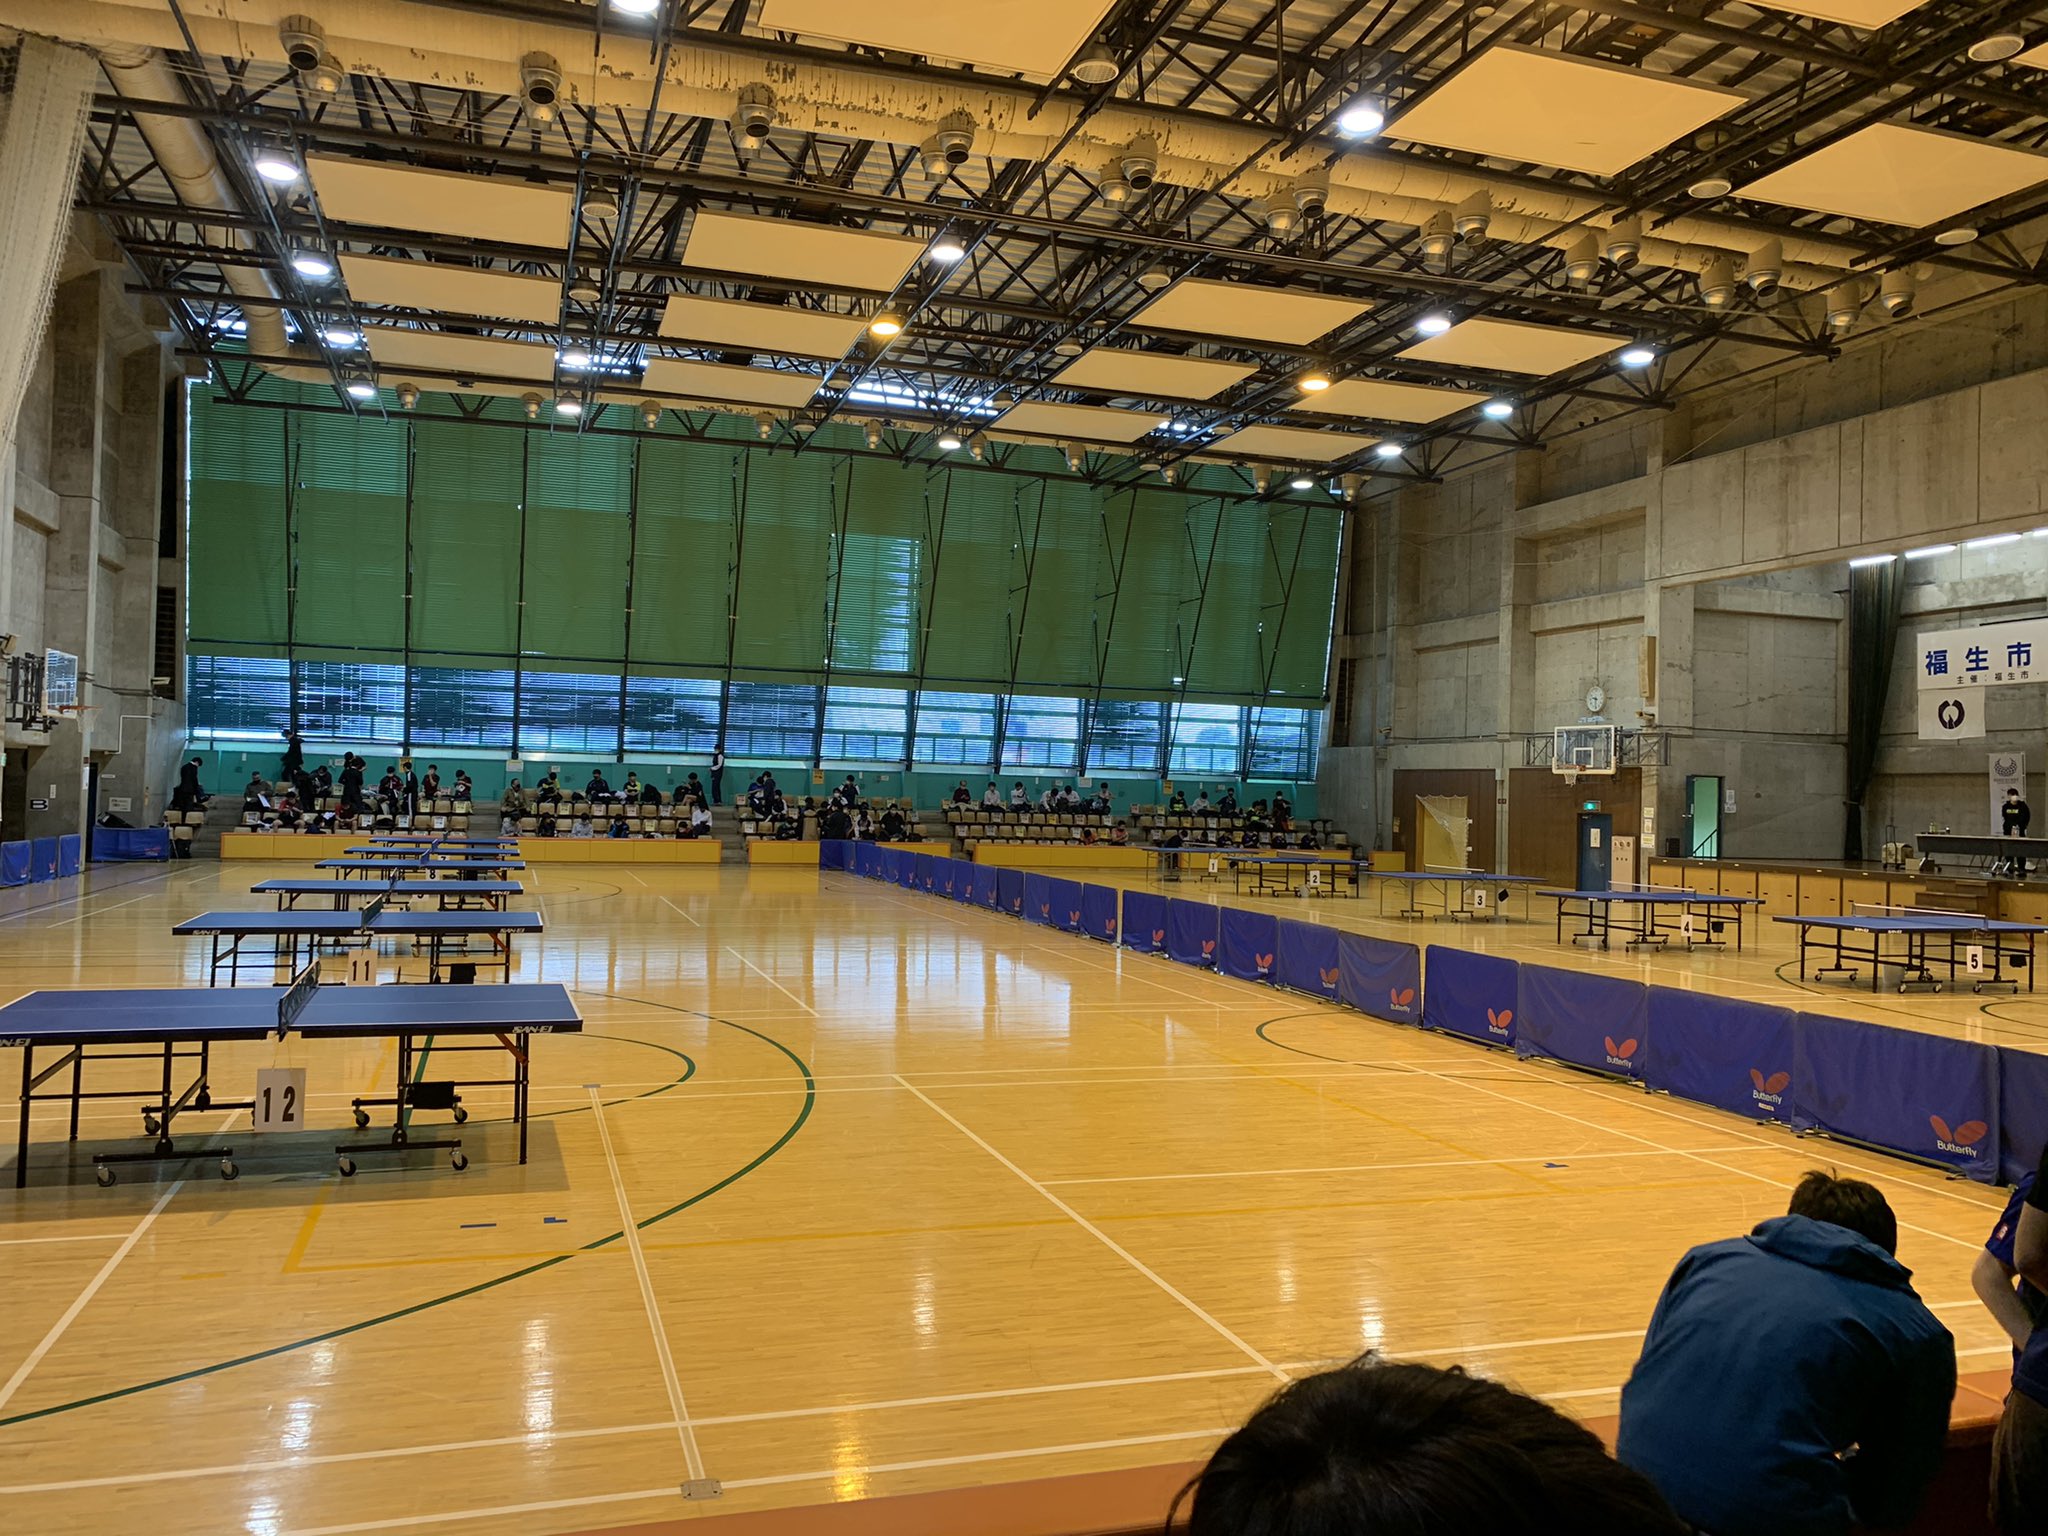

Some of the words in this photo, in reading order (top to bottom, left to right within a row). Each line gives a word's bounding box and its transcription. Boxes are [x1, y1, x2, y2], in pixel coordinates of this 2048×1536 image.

[1925, 641, 2032, 676] 福生市
[429, 868, 436, 880] 8
[1477, 895, 1483, 906] 3
[1684, 921, 1690, 934] 4
[1971, 953, 1979, 970] 5
[352, 959, 371, 982] 11
[1606, 1055, 1633, 1069] Butterfly
[262, 1086, 296, 1123] 12
[1752, 1089, 1782, 1105] Butterfly
[1936, 1139, 1978, 1158] Butterfly
